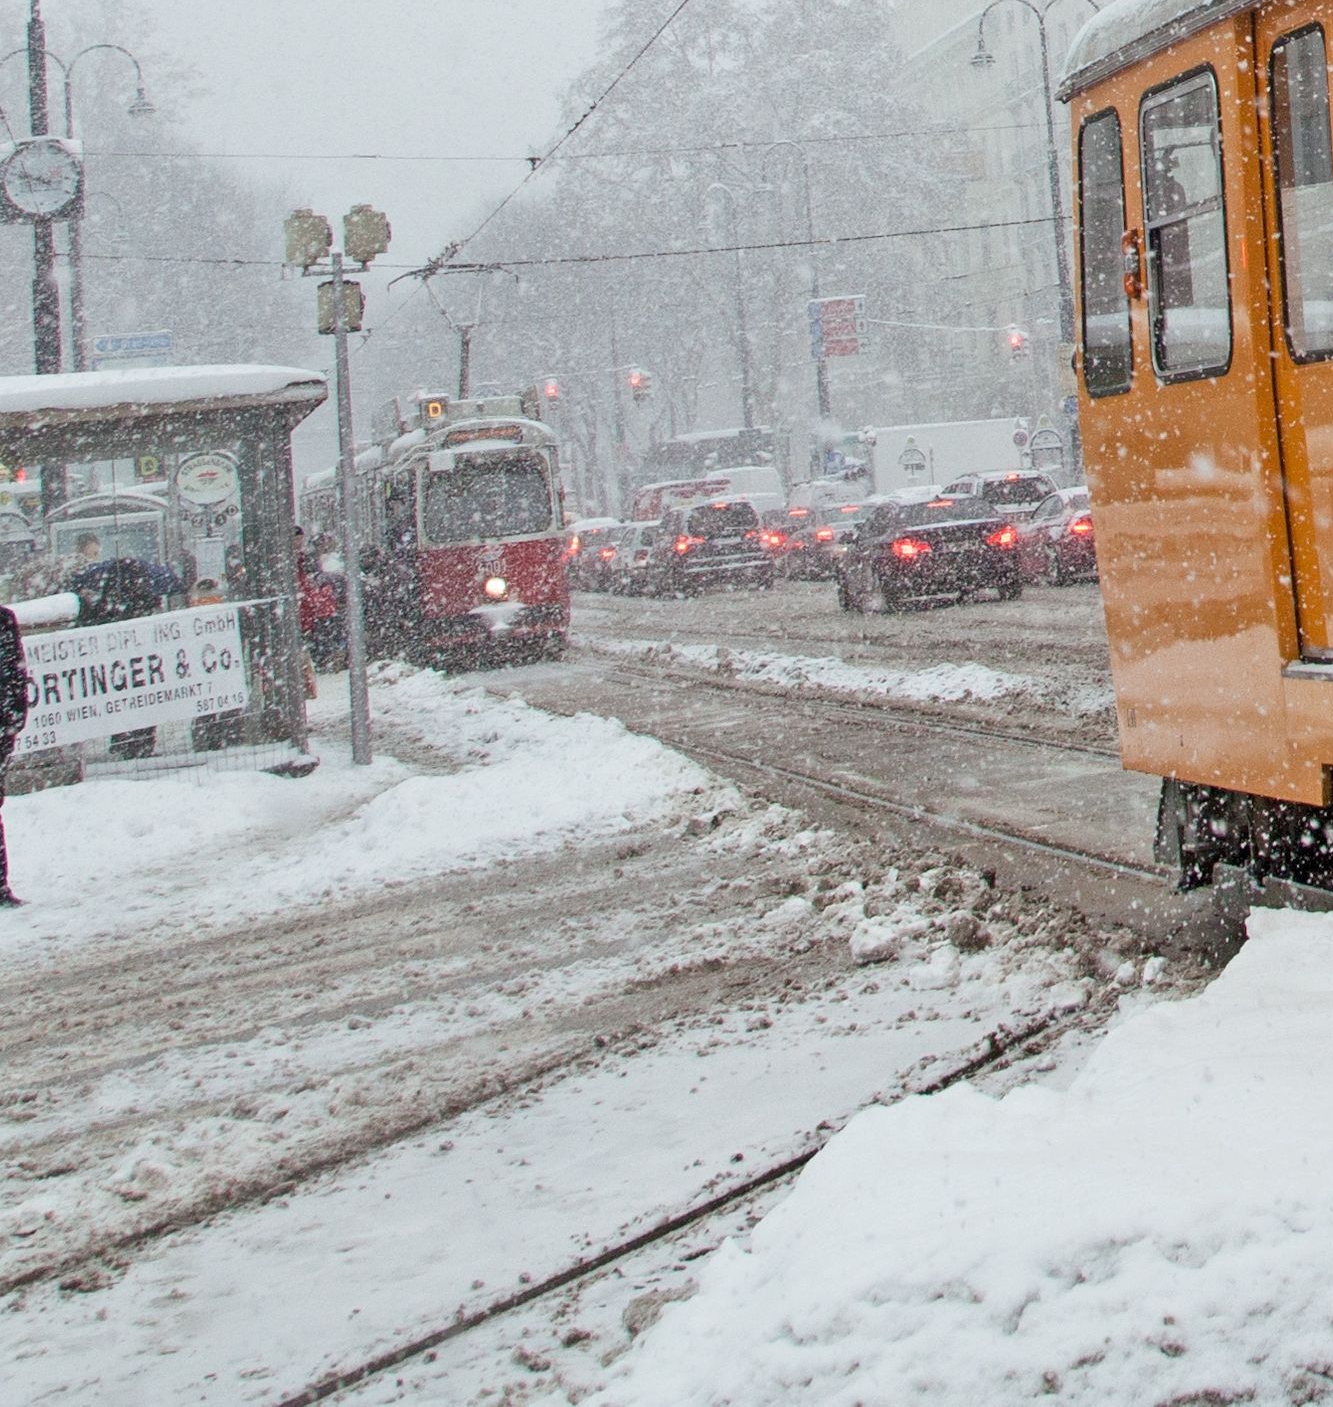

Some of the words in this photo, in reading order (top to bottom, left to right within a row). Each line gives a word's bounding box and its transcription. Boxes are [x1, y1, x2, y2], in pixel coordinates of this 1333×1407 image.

[428, 402, 442, 418] D
[193, 613, 235, 636] GmbH
[176, 648, 191, 679] &
[202, 643, 239, 673] Co.
[33, 712, 62, 729] 1060
[106, 683, 203, 714] GETREIDEMARKT
[197, 698, 215, 712] 587
